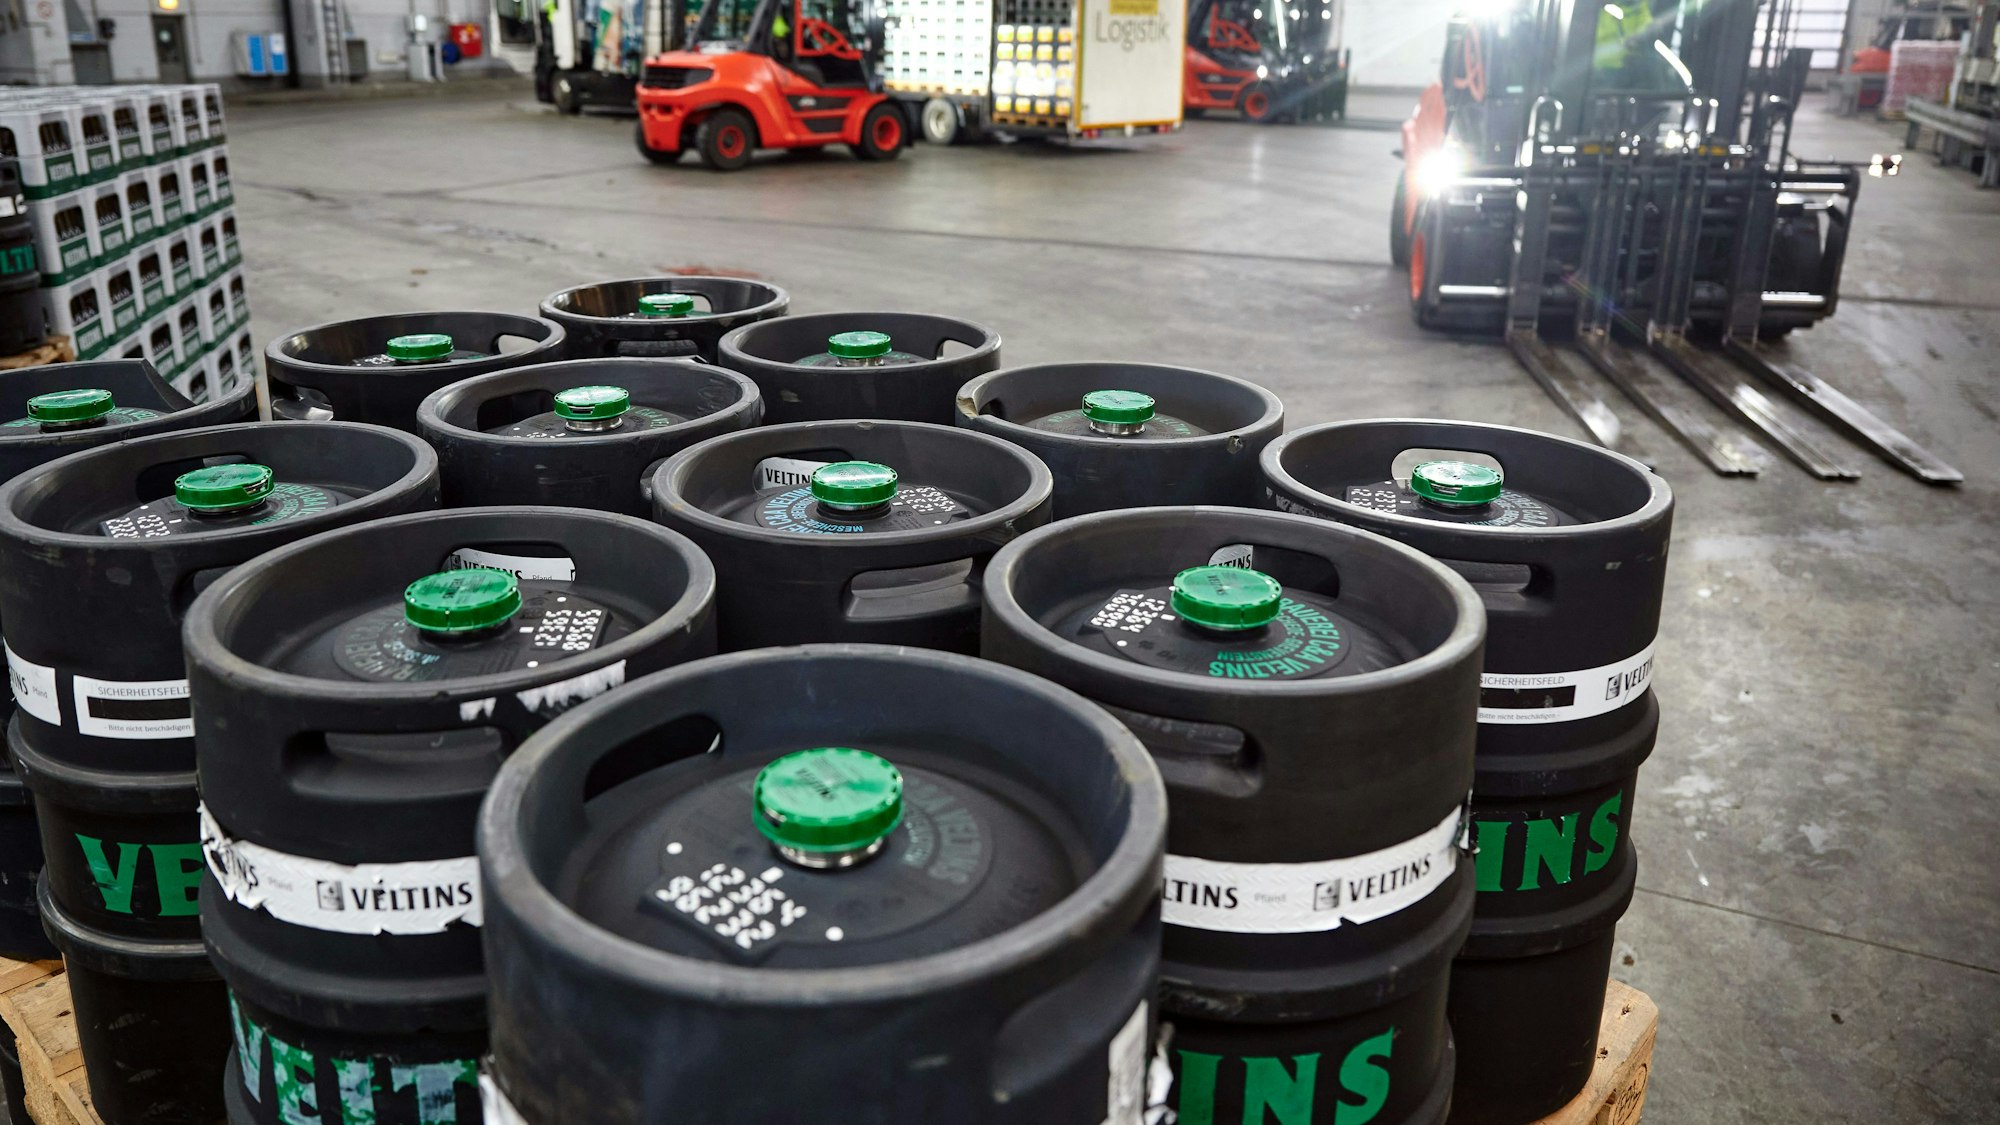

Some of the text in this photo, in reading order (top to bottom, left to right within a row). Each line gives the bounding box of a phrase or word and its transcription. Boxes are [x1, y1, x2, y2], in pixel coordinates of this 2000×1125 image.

[1096, 9, 1170, 52] Logistik
[765, 467, 812, 486] VELTIN
[764, 486, 812, 509] VELTIN
[1350, 488, 1372, 508] 1213
[105, 516, 141, 539] 2322
[1210, 554, 1251, 569] TINS
[1208, 597, 1341, 678] RAUEREI C&A VELTINS
[97, 685, 191, 698] SICHERHEITSFELD
[1479, 676, 1566, 689] SICHERHEITSFELD
[1497, 712, 1514, 721] nicht
[1516, 712, 1557, 724] beschädigen
[108, 724, 124, 732] Bitte
[126, 725, 143, 733] nicht
[145, 724, 191, 735] beschädigen
[74, 833, 205, 917] VE
[1348, 853, 1432, 903] VELTINS
[352, 881, 473, 912] VELTINS
